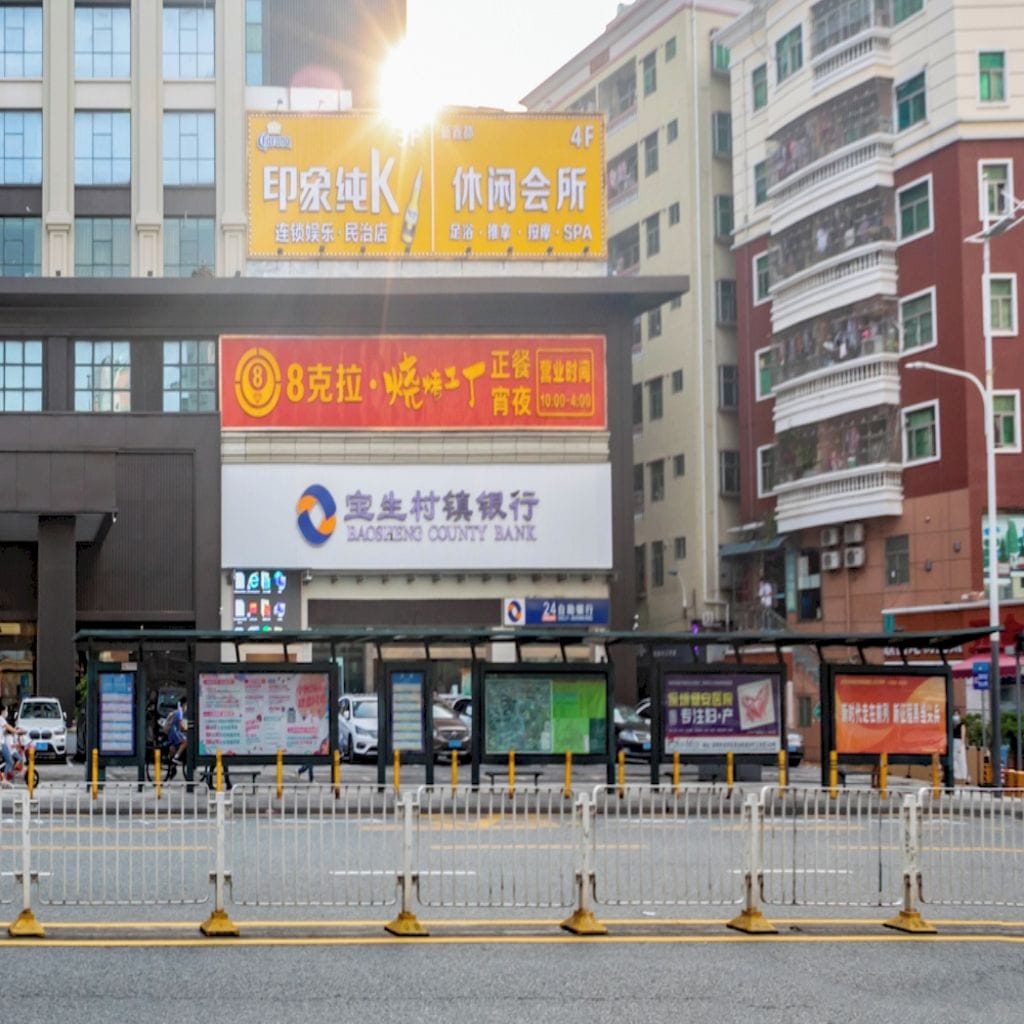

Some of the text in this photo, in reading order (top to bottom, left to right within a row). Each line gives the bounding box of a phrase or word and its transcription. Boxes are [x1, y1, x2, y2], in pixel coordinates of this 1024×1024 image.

[570, 125, 595, 148] 4F
[263, 147, 400, 214] 印象纯K
[453, 166, 587, 212] 休闲会所
[564, 224, 593, 241] SPA
[490, 349, 531, 379] 正餐
[539, 359, 591, 384] 营业时间
[490, 386, 532, 417] 宵夜
[343, 489, 540, 522] 宝生村镇银行
[347, 525, 537, 543] BAOSHENG COUNTY BANK
